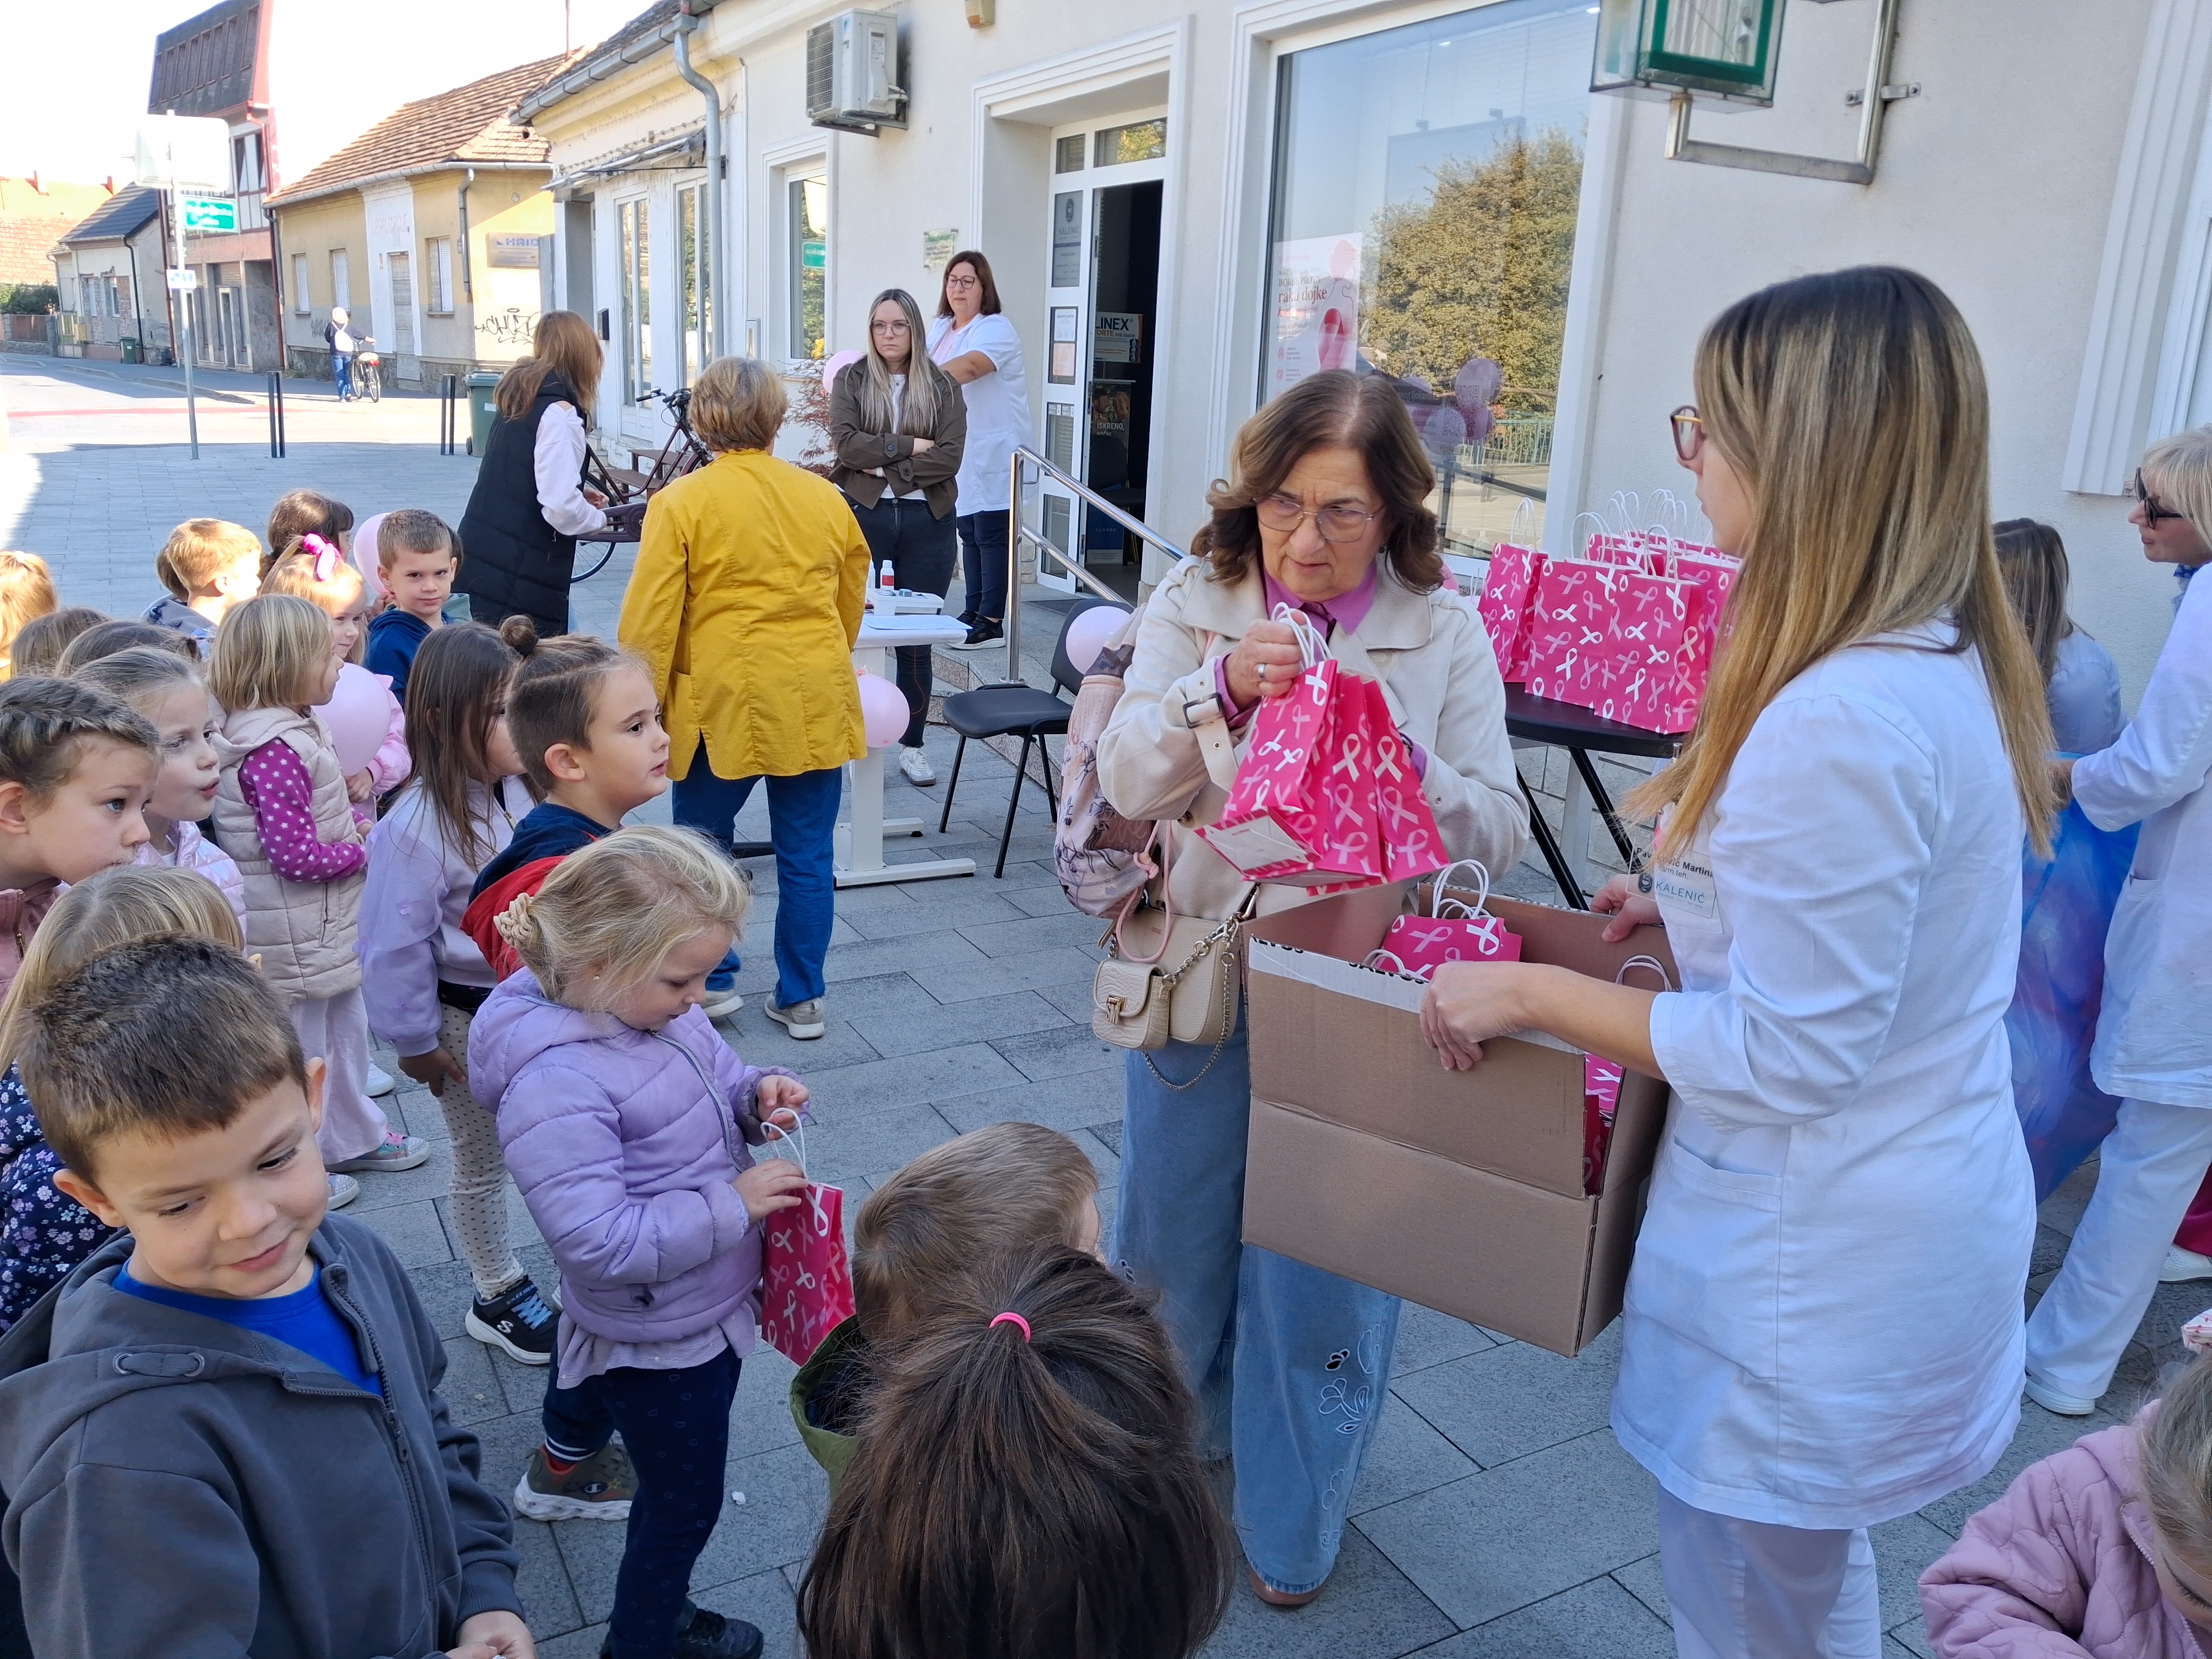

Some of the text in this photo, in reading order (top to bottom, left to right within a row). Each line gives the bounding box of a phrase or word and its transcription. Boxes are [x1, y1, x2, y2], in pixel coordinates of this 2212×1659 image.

[1278, 285, 1327, 305] raka dojke
[1097, 422, 1124, 432] ISKRENO,
[1682, 861, 1714, 878] Martina
[1656, 880, 1705, 903] KALENIĆ
